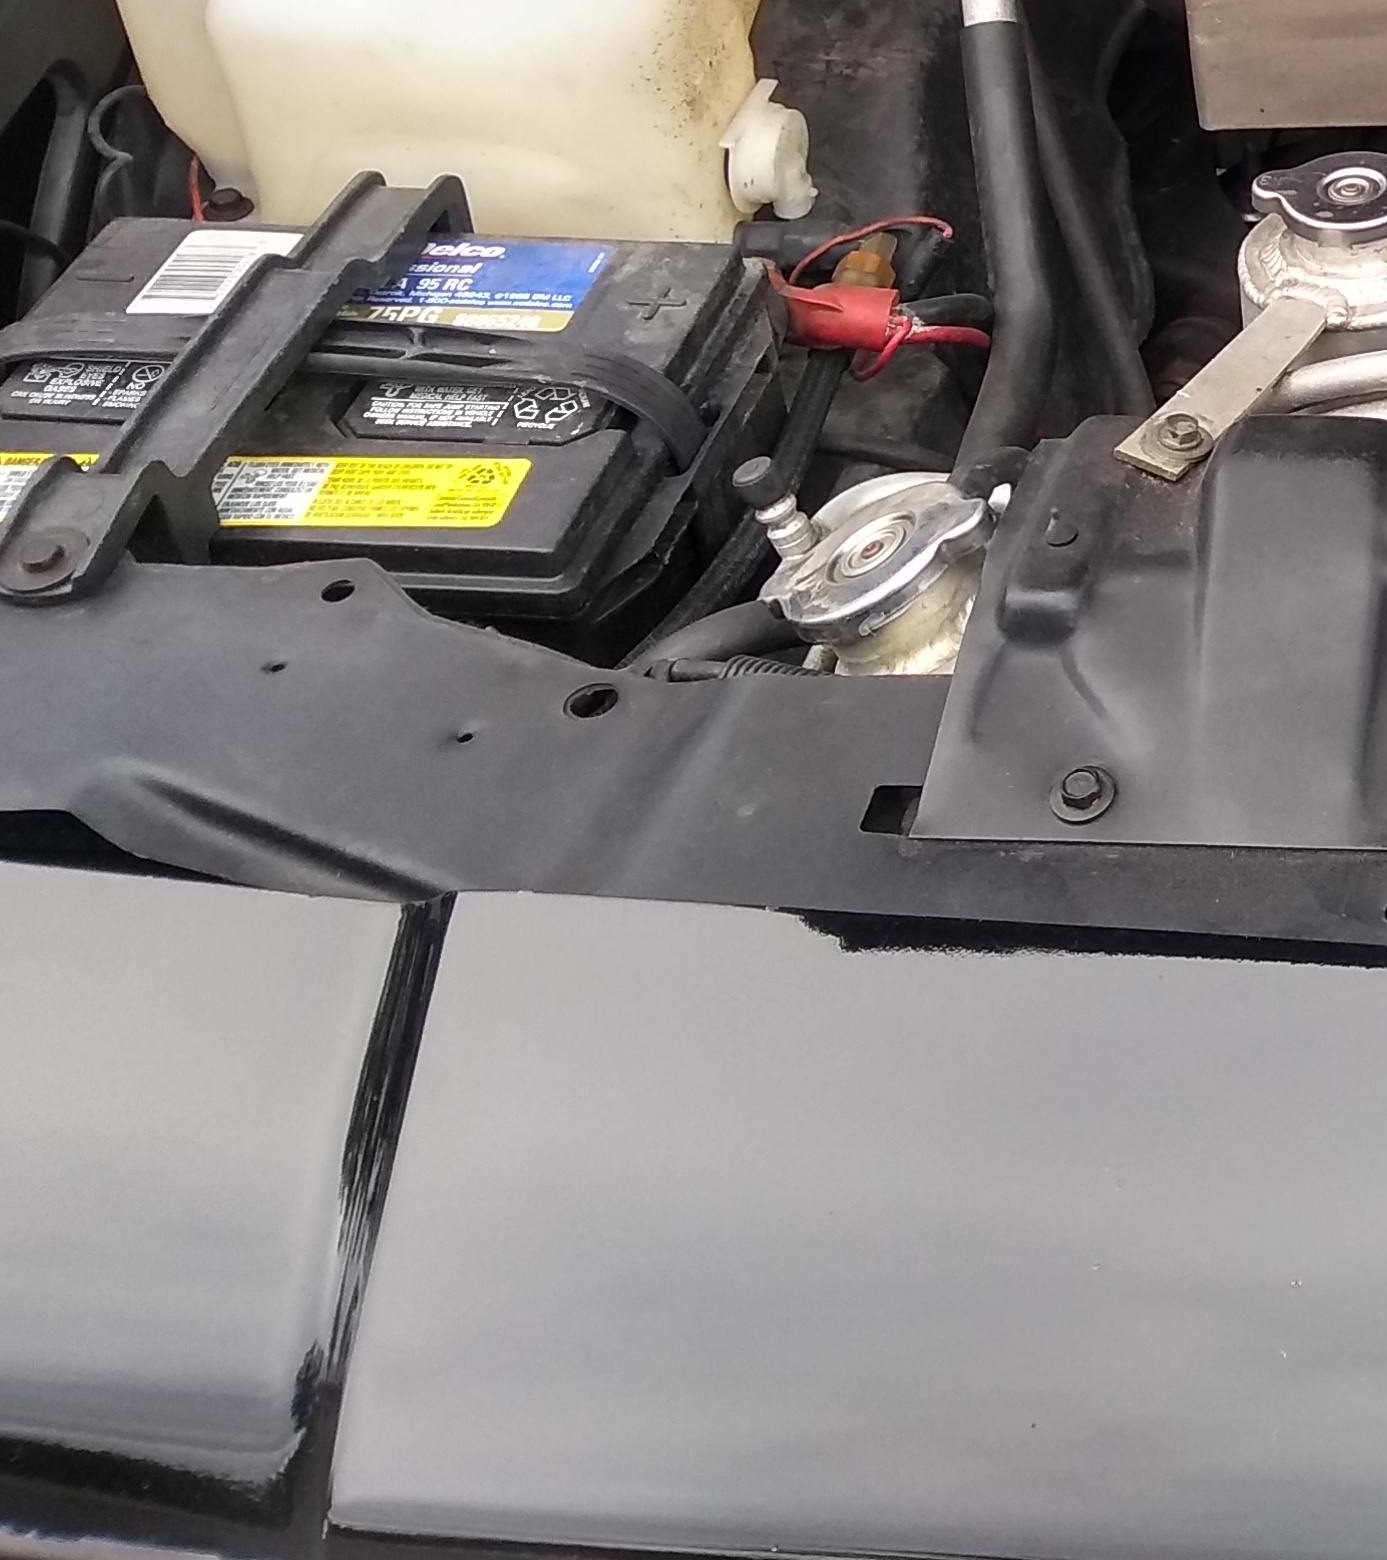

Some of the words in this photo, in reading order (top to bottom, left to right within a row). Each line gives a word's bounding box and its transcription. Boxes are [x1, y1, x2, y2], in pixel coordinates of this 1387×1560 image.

[416, 278, 443, 290] 95
[442, 278, 474, 291] RC
[552, 294, 572, 302] LLC
[87, 364, 122, 373] SHIELD
[49, 377, 105, 387] EXPLOSIVE
[126, 381, 146, 389] NO
[409, 392, 443, 400] MEDICAL
